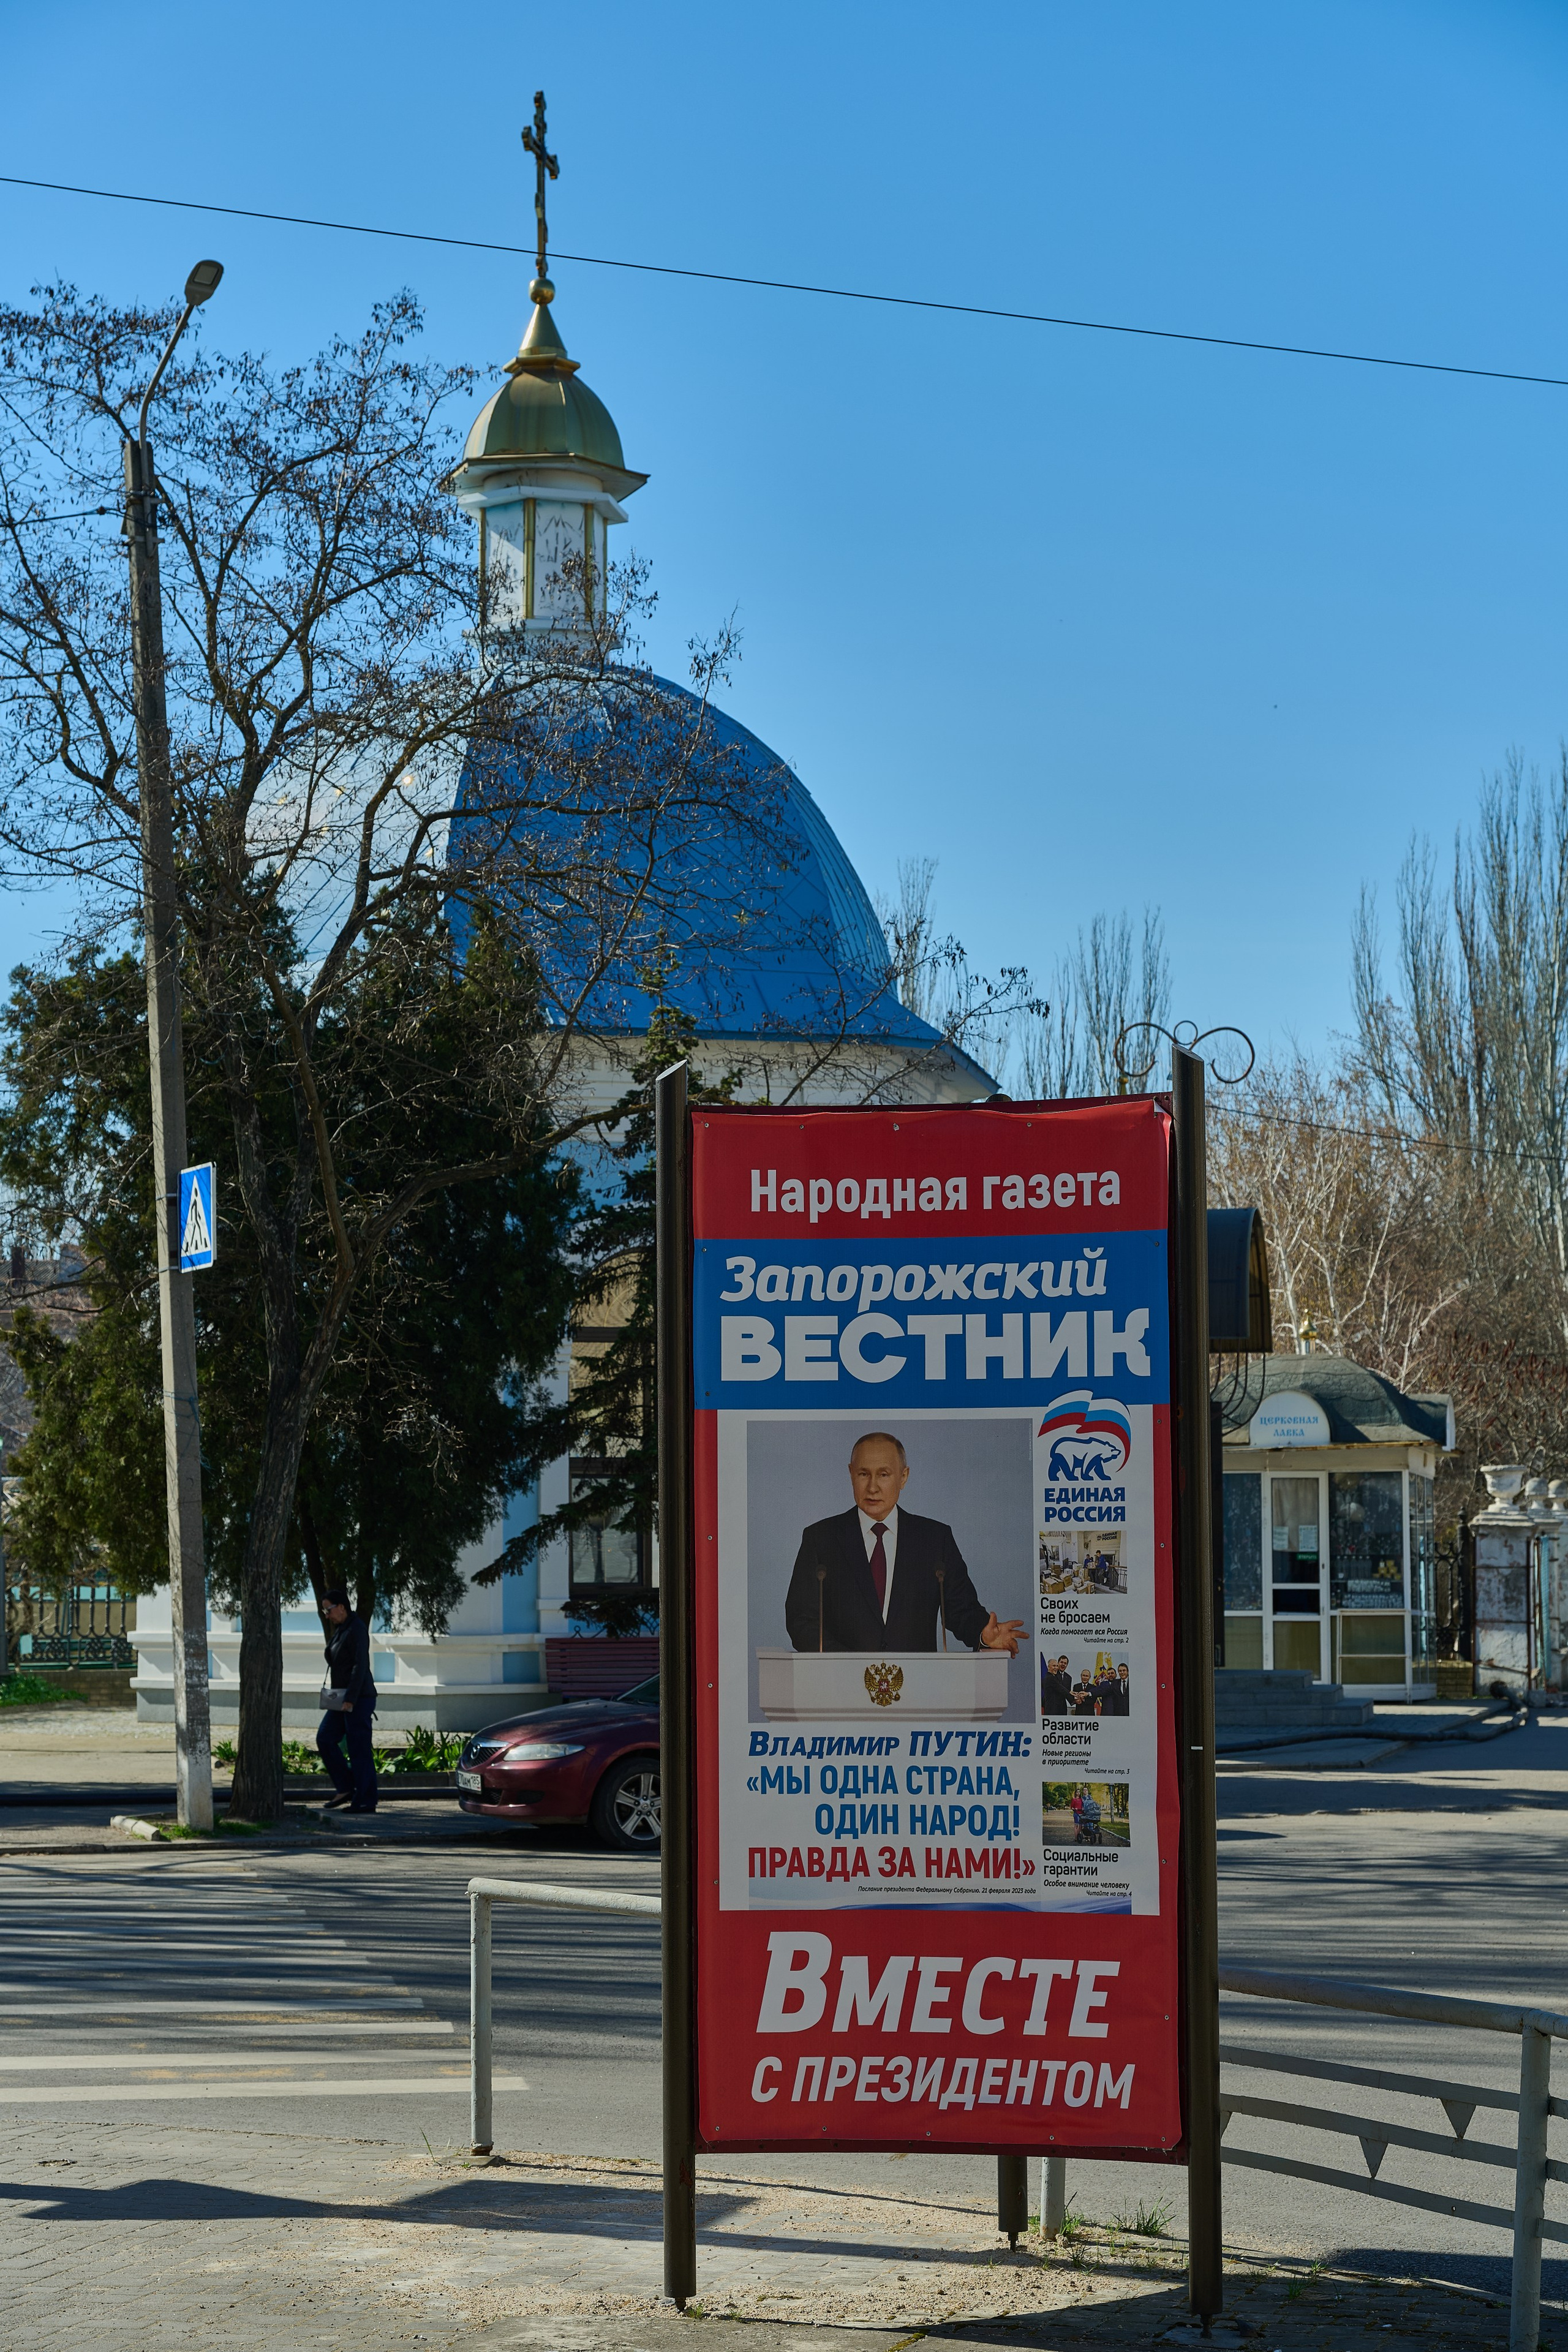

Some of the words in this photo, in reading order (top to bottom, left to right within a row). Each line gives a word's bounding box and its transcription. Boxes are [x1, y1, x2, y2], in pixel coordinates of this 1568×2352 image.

[752, 1170, 967, 1223] Народная
[984, 1171, 1120, 1209] газета
[720, 1247, 1107, 1313] Запорожский
[722, 1308, 1150, 1382] ВЕСТНИК
[1260, 1416, 1319, 1426] ЦЕРКОВНАЯ
[1273, 1428, 1305, 1437] ЛАВКА
[1045, 1487, 1125, 1504] ЕДИНАЯ
[1045, 1506, 1125, 1522] РОССИЯ
[1041, 1597, 1078, 1609] Своих
[1041, 1614, 1055, 1623] не
[1059, 1611, 1110, 1626] бросаем
[1042, 1719, 1099, 1731] Развитие
[748, 1732, 899, 1759] ВЛАДИМИР
[910, 1732, 1031, 1757] ПУТИН:
[1042, 1732, 1090, 1744] области
[747, 1766, 810, 1794] «МЫ
[821, 1765, 899, 1798] ОДНА
[907, 1766, 1019, 1801] СТРАНА,
[815, 1804, 899, 1839] ОДИН
[910, 1804, 1019, 1841] НАРОД!
[748, 1847, 870, 1882] ПРАВДА
[878, 1847, 916, 1877] ЗА
[925, 1847, 1035, 1879] НАМИ!»
[1044, 1849, 1118, 1863] Социальные
[1044, 1866, 1097, 1878] гарантии
[756, 1932, 1120, 2038] ВМЕСТЕ
[752, 2057, 782, 2102] С
[791, 2056, 1135, 2110] ПРЕЗИДЕНТОМ
